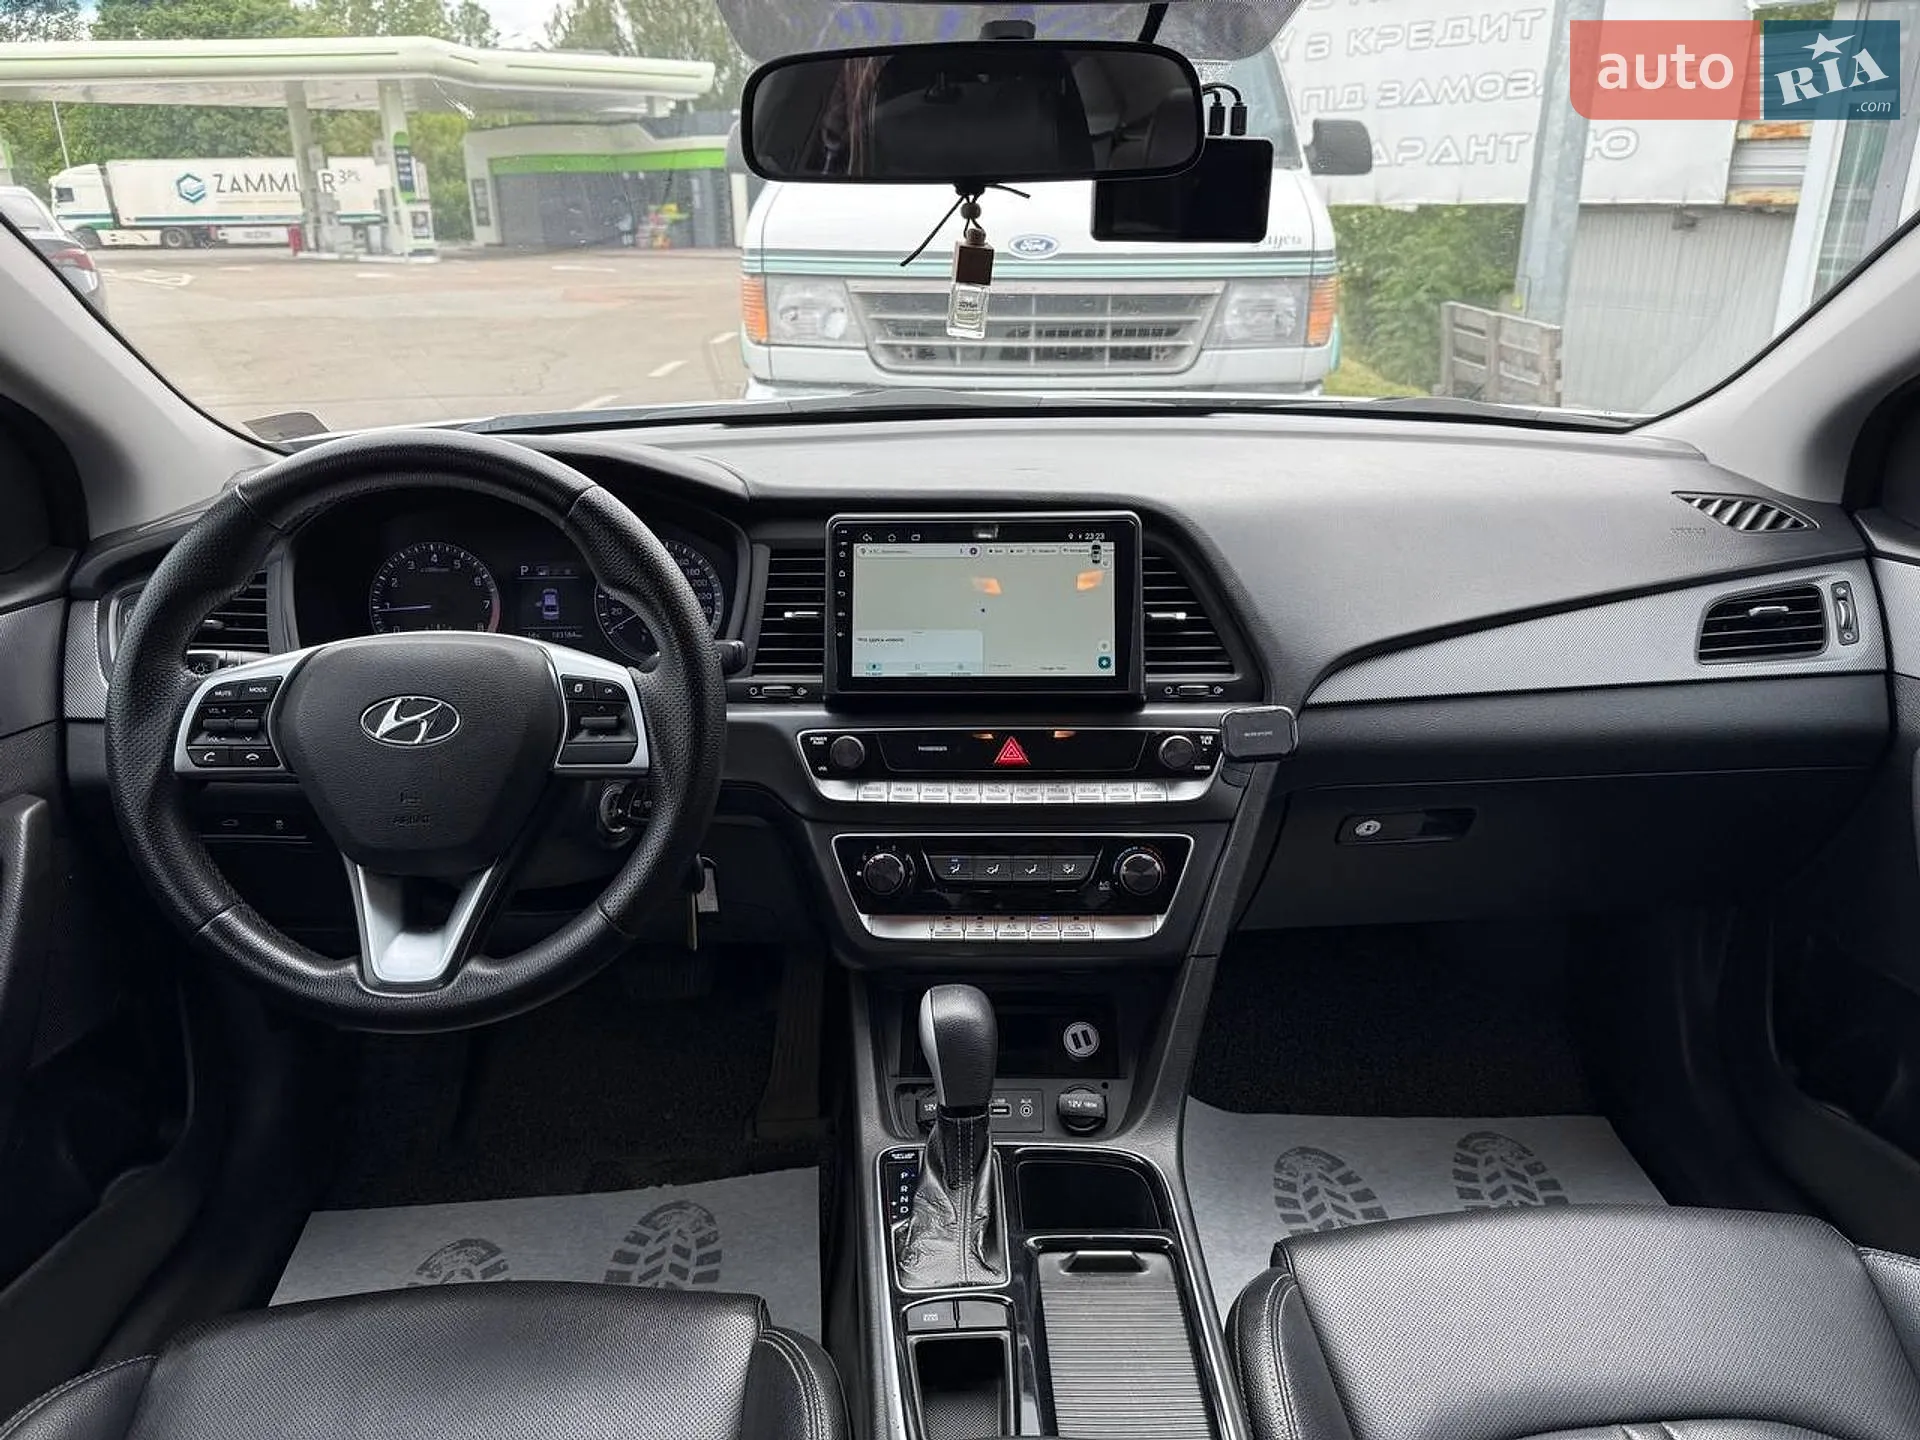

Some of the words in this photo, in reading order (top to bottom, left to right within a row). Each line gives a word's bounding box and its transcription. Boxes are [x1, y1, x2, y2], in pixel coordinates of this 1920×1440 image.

[1346, 9, 1546, 58] КРЕДИТ
[1301, 83, 1365, 113] ПІД
[1374, 71, 1543, 109] ЗАМОВ
[212, 172, 336, 193] ZAMMLR
[520, 566, 529, 575] P
[900, 1171, 908, 1179] P
[900, 1195, 909, 1203] N
[900, 1205, 909, 1214] D
